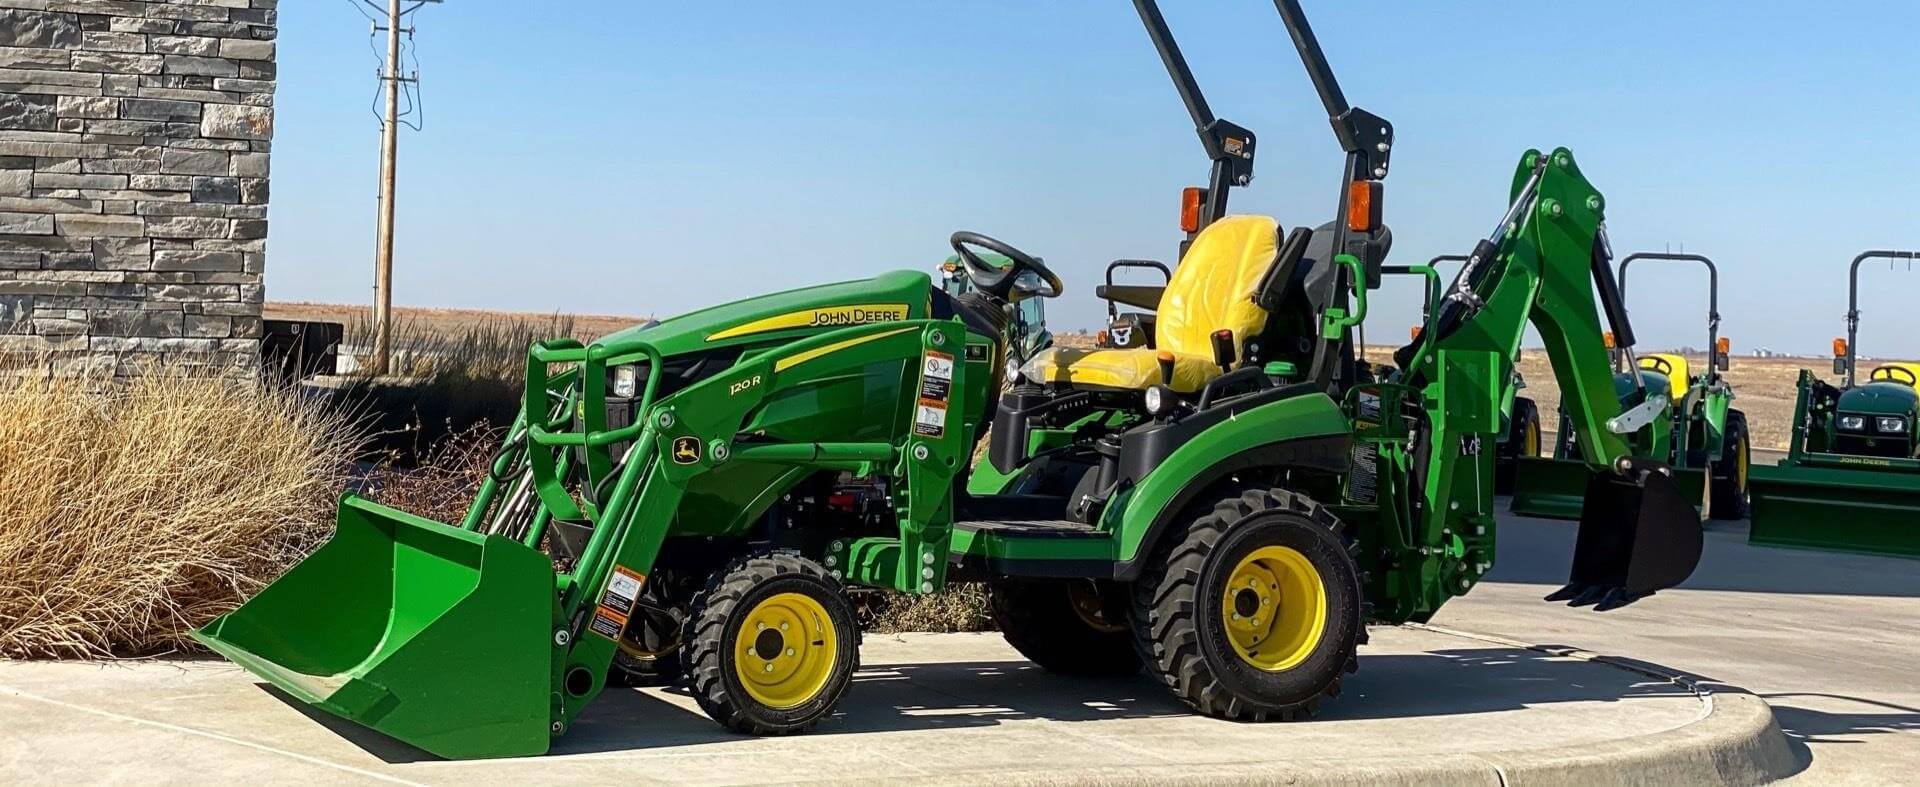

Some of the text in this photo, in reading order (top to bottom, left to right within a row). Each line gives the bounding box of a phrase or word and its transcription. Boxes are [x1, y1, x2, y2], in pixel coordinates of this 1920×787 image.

[809, 309, 901, 325] JOHN DEERE
[1840, 456, 1862, 464] JOHN
